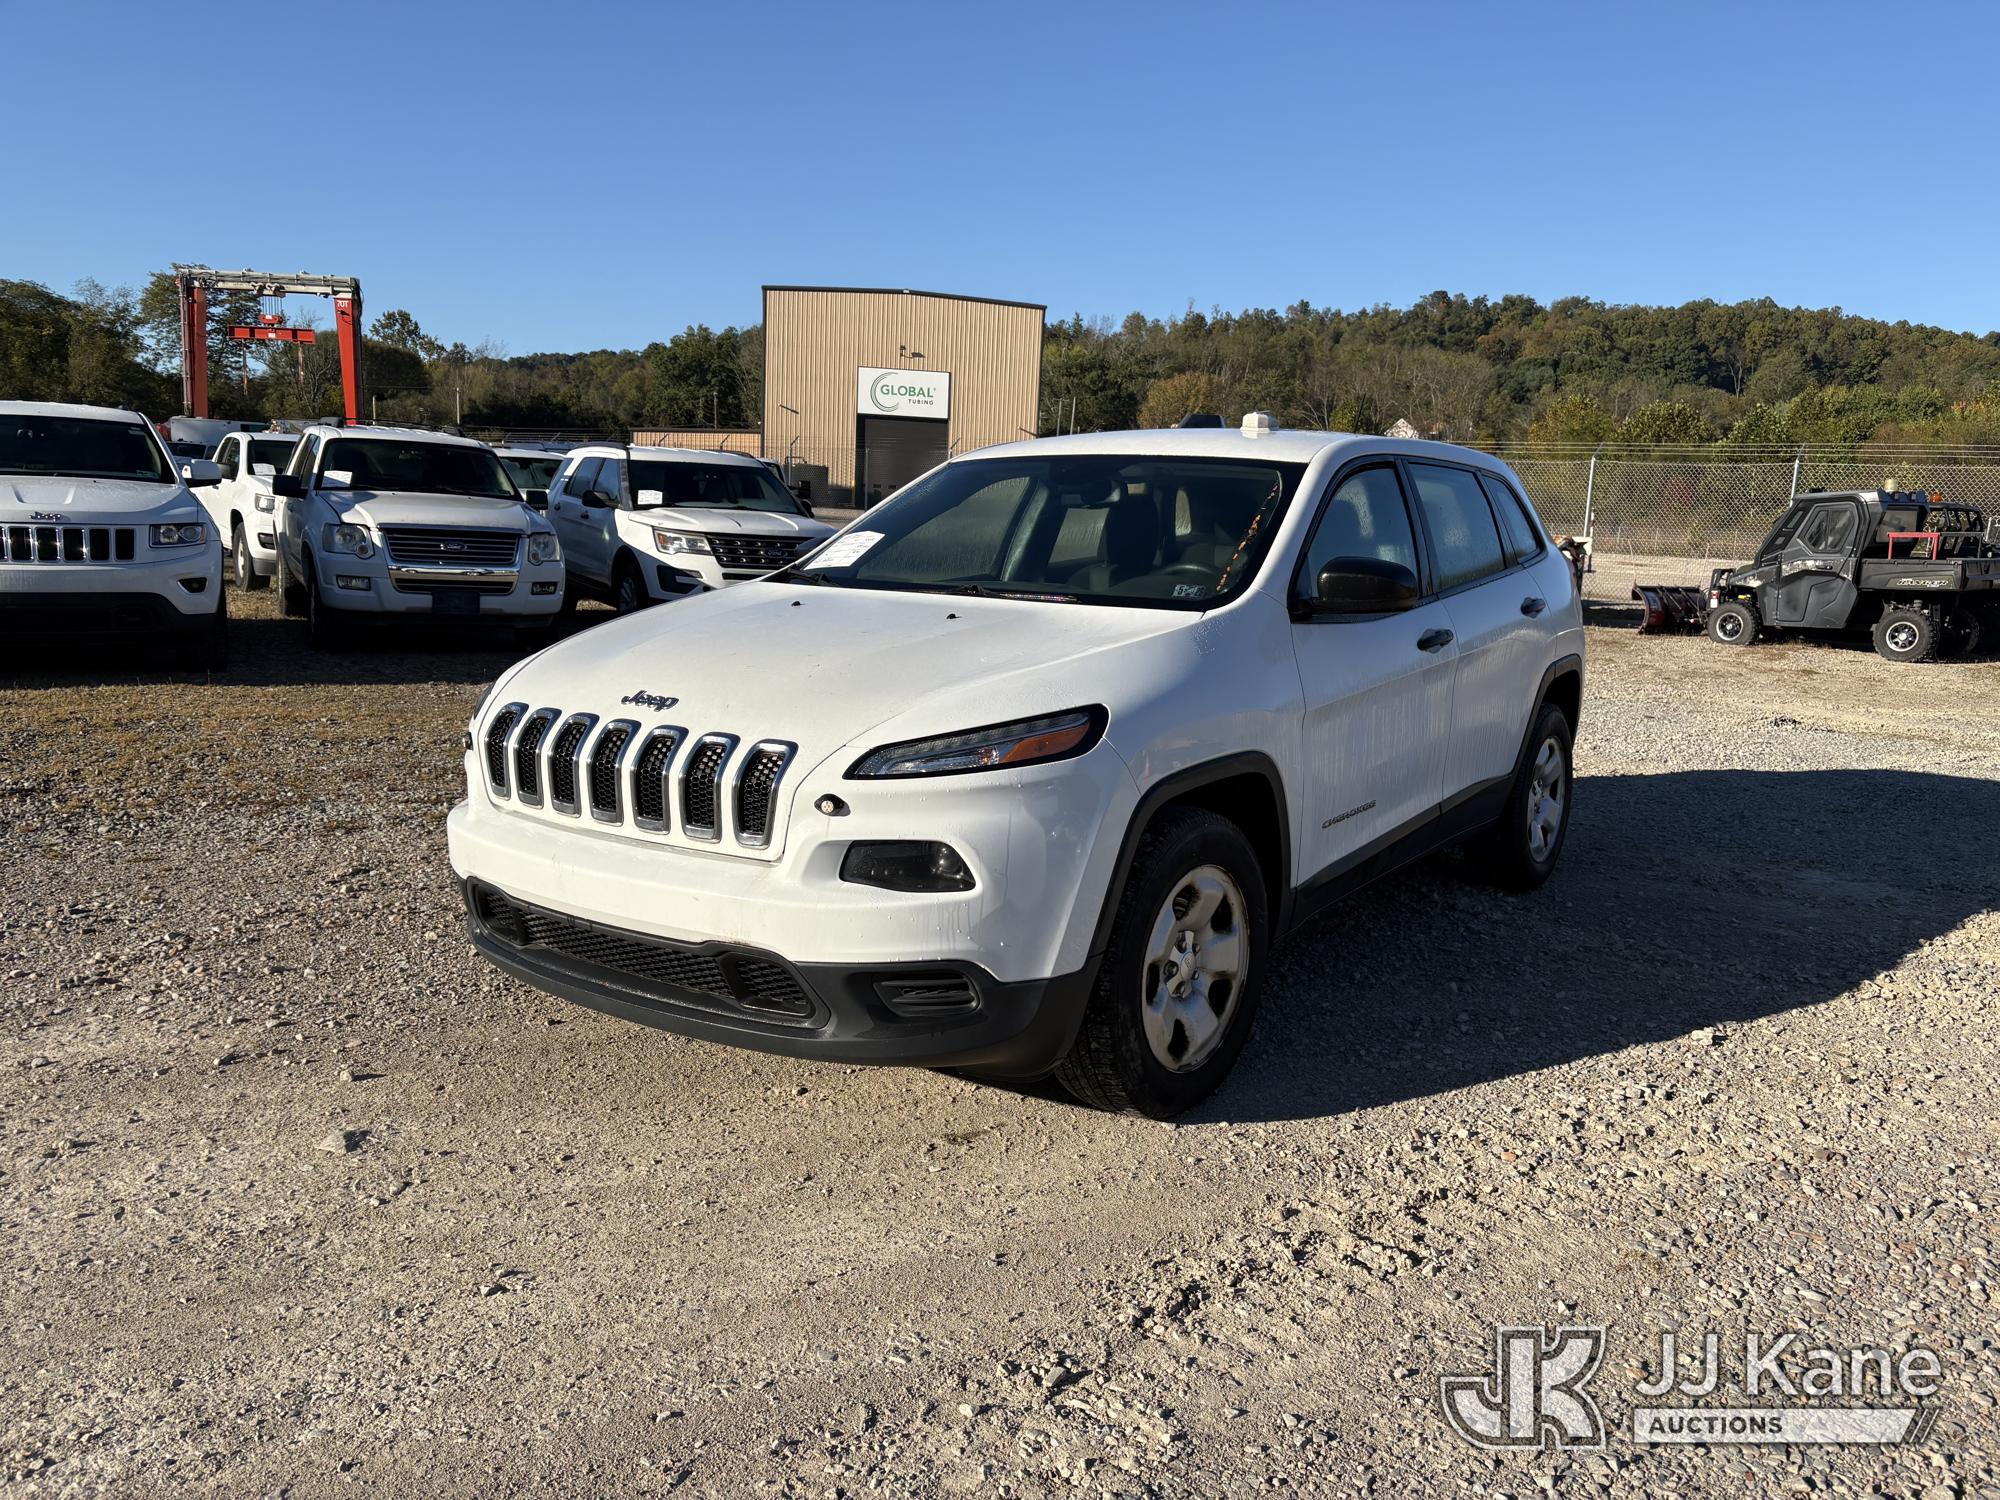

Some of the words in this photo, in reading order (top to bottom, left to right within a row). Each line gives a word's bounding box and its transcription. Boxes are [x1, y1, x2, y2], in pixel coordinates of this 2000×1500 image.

[880, 384, 934, 398] GLOBAL
[908, 398, 934, 406] TUBING
[620, 689, 680, 712] Jeep
[1321, 799, 1377, 829] CHEROKEE
